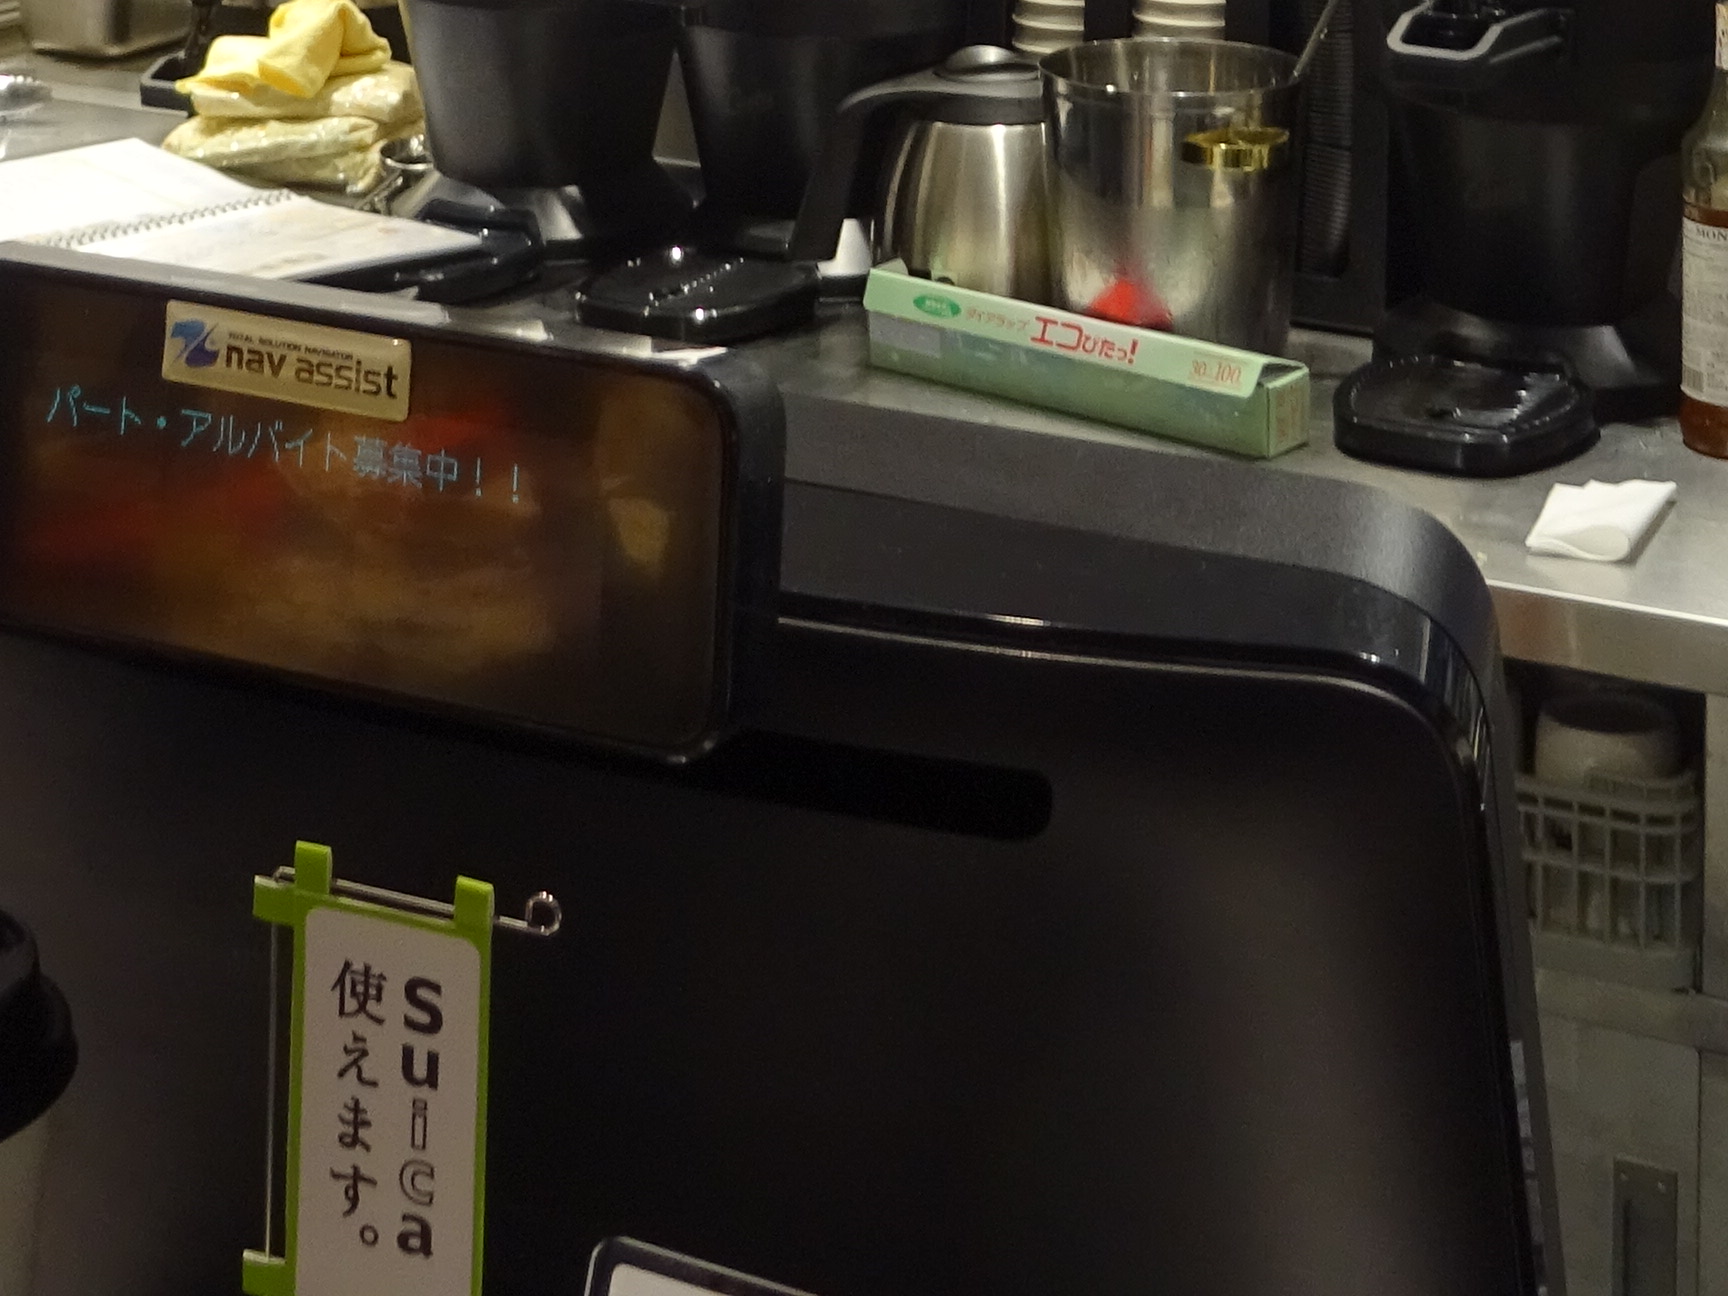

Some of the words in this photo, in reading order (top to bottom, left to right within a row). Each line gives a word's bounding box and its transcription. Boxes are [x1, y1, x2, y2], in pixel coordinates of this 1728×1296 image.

[225, 345, 287, 379] nav
[294, 360, 398, 400] assist
[330, 959, 387, 1247] 使えます。
